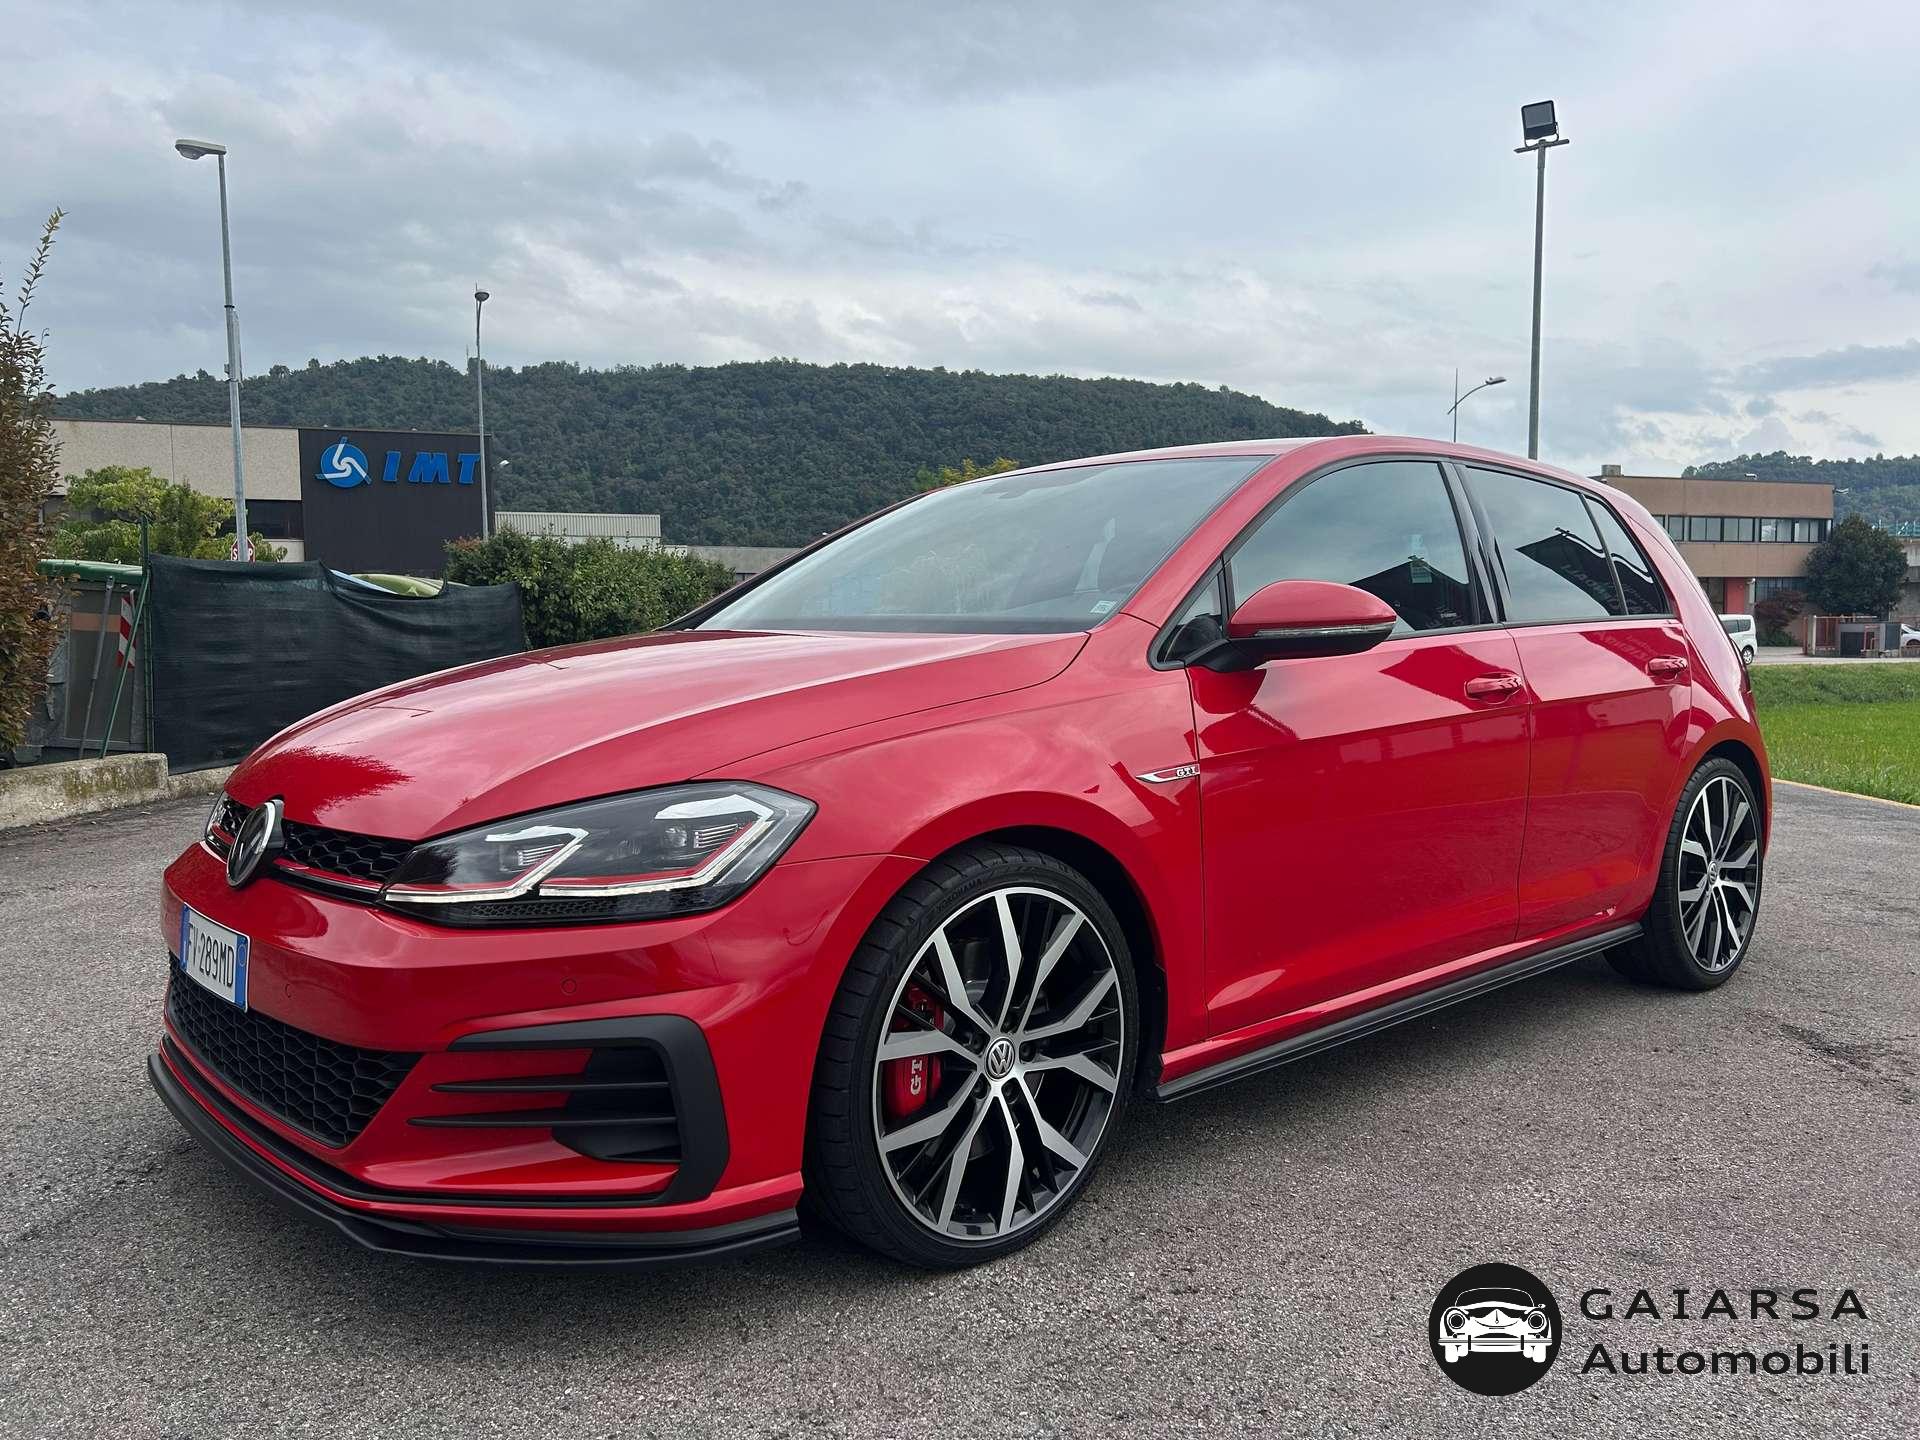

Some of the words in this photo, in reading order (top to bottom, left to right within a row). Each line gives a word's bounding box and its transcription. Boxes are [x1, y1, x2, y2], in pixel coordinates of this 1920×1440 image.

[382, 450, 481, 485] IMT
[232, 547, 254, 561] SP
[1176, 765, 1196, 777] GTI
[910, 1059, 923, 1095] GT
